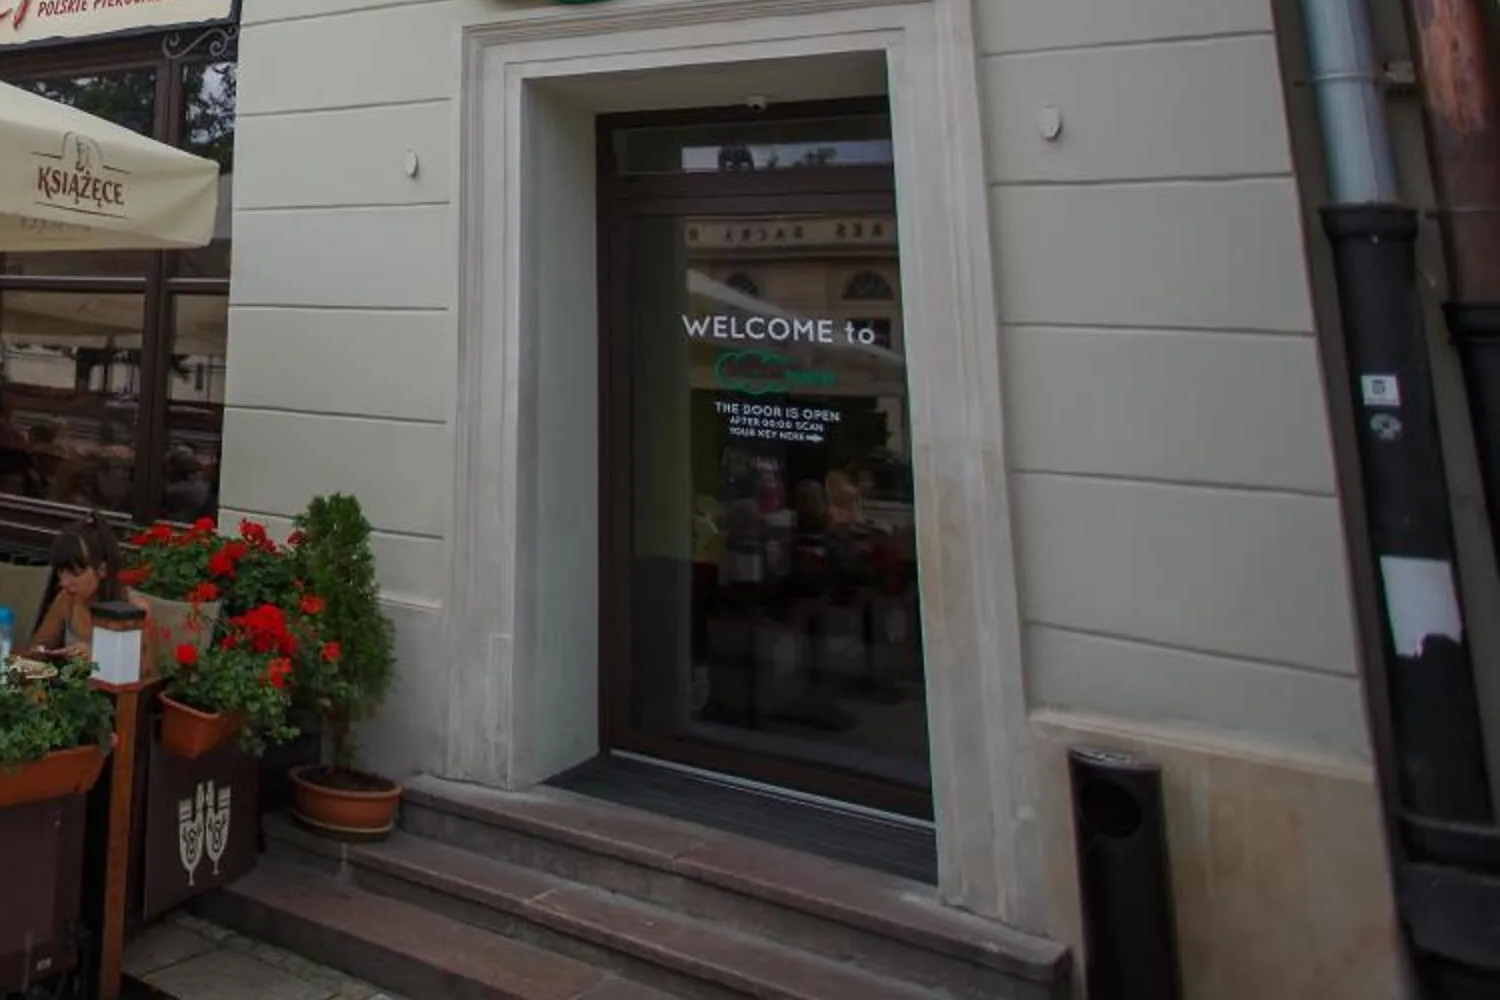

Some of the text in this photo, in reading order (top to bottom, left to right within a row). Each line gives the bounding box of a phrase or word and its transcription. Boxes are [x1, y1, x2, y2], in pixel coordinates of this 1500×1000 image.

[37, 165, 125, 208] KSIĄŻĘCE
[682, 315, 875, 345] WELCOME to
[715, 402, 841, 422] THE DOOR IS OPEN
